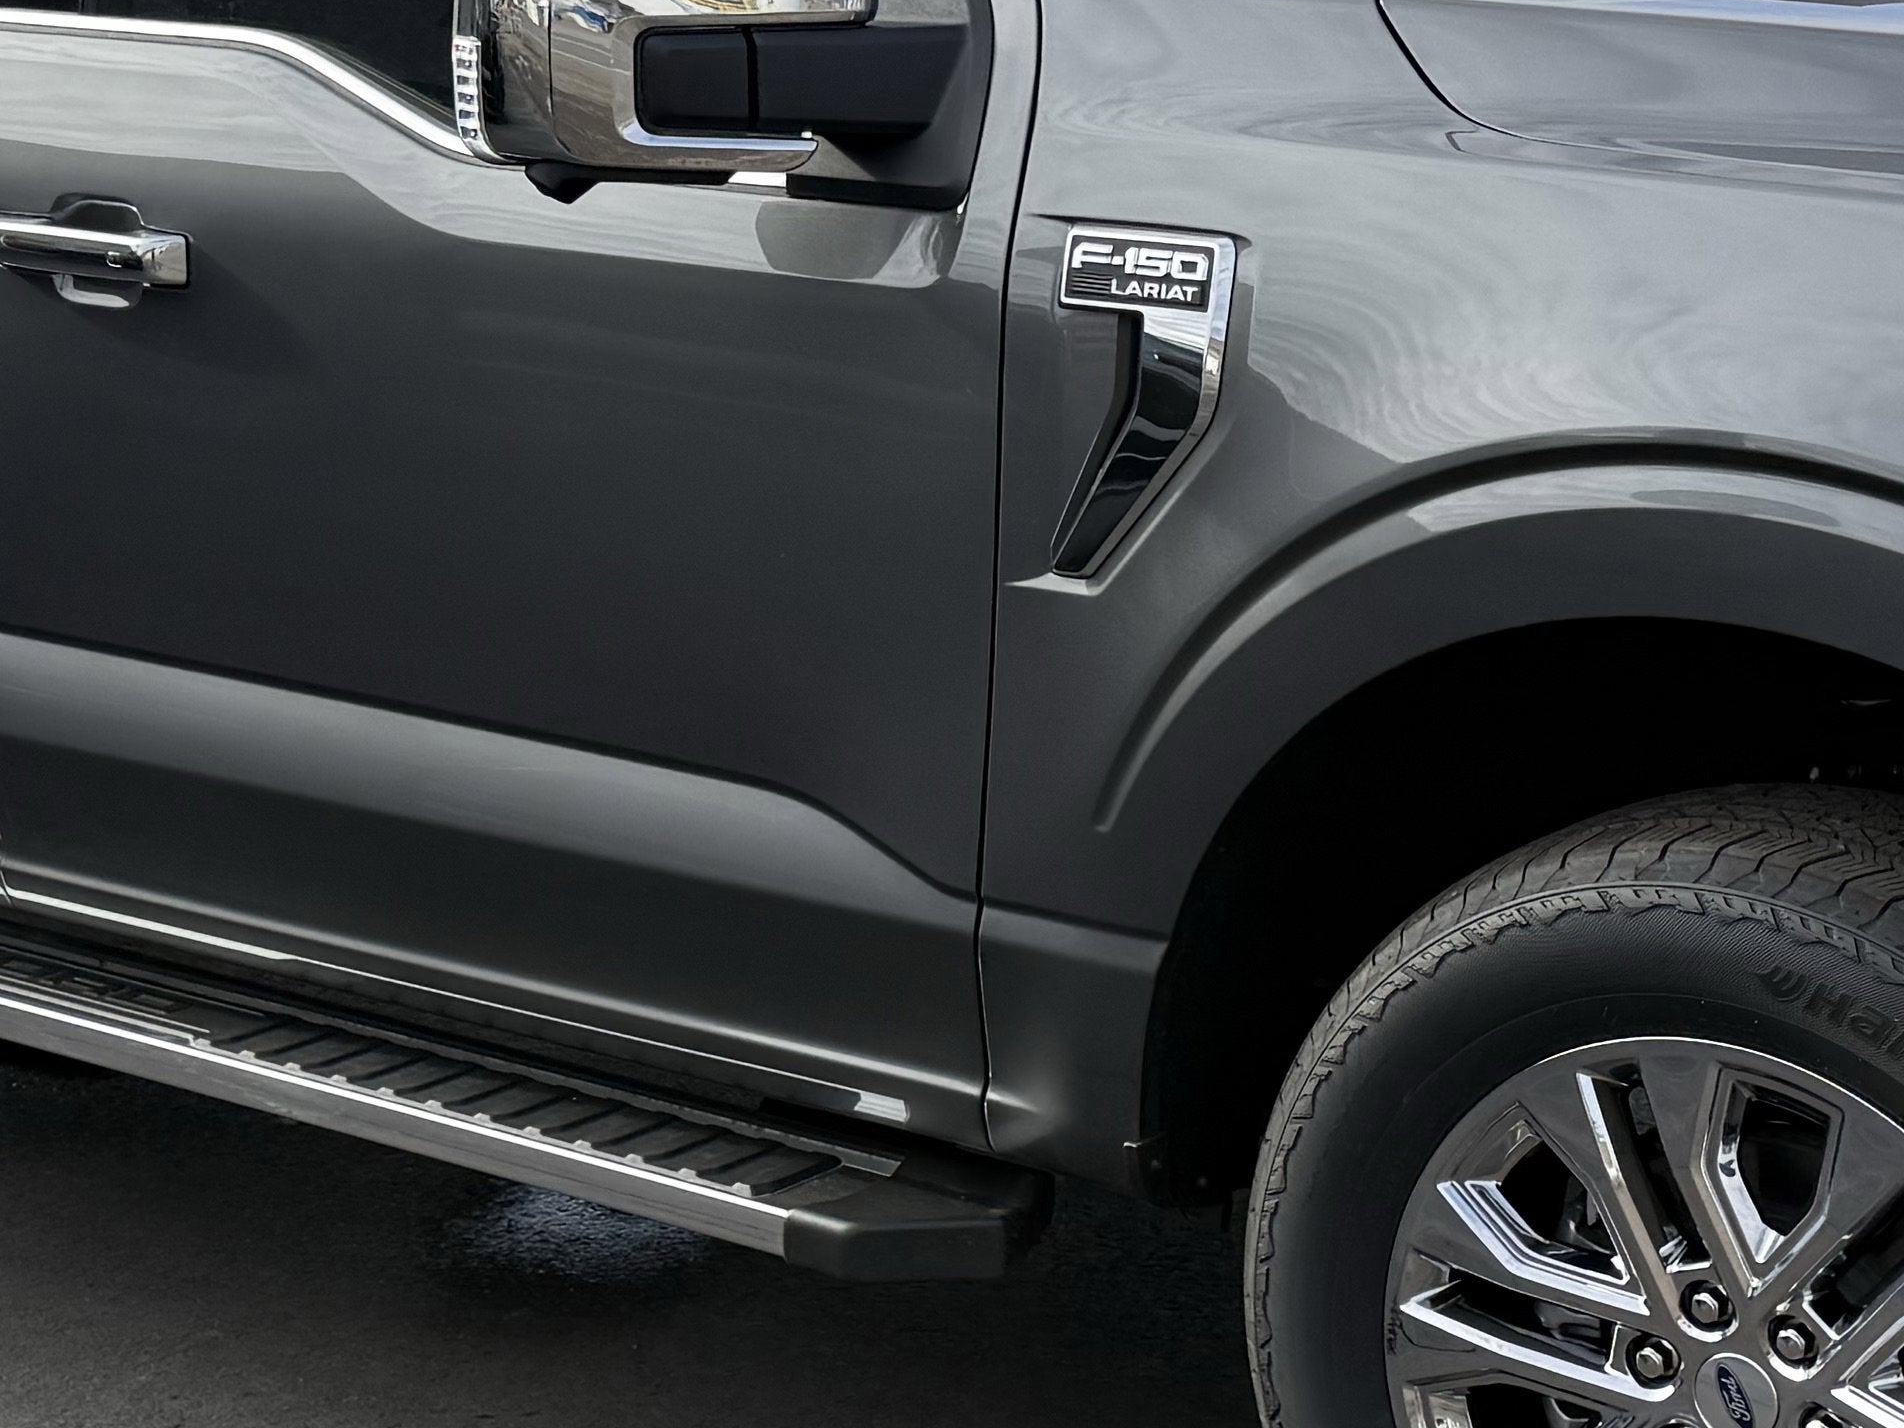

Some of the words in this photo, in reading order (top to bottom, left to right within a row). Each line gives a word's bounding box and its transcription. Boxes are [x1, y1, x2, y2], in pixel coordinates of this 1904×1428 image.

[1071, 241, 1210, 281] F-150
[1110, 278, 1199, 302] LARIAT
[1720, 1375, 1752, 1422] Ford
